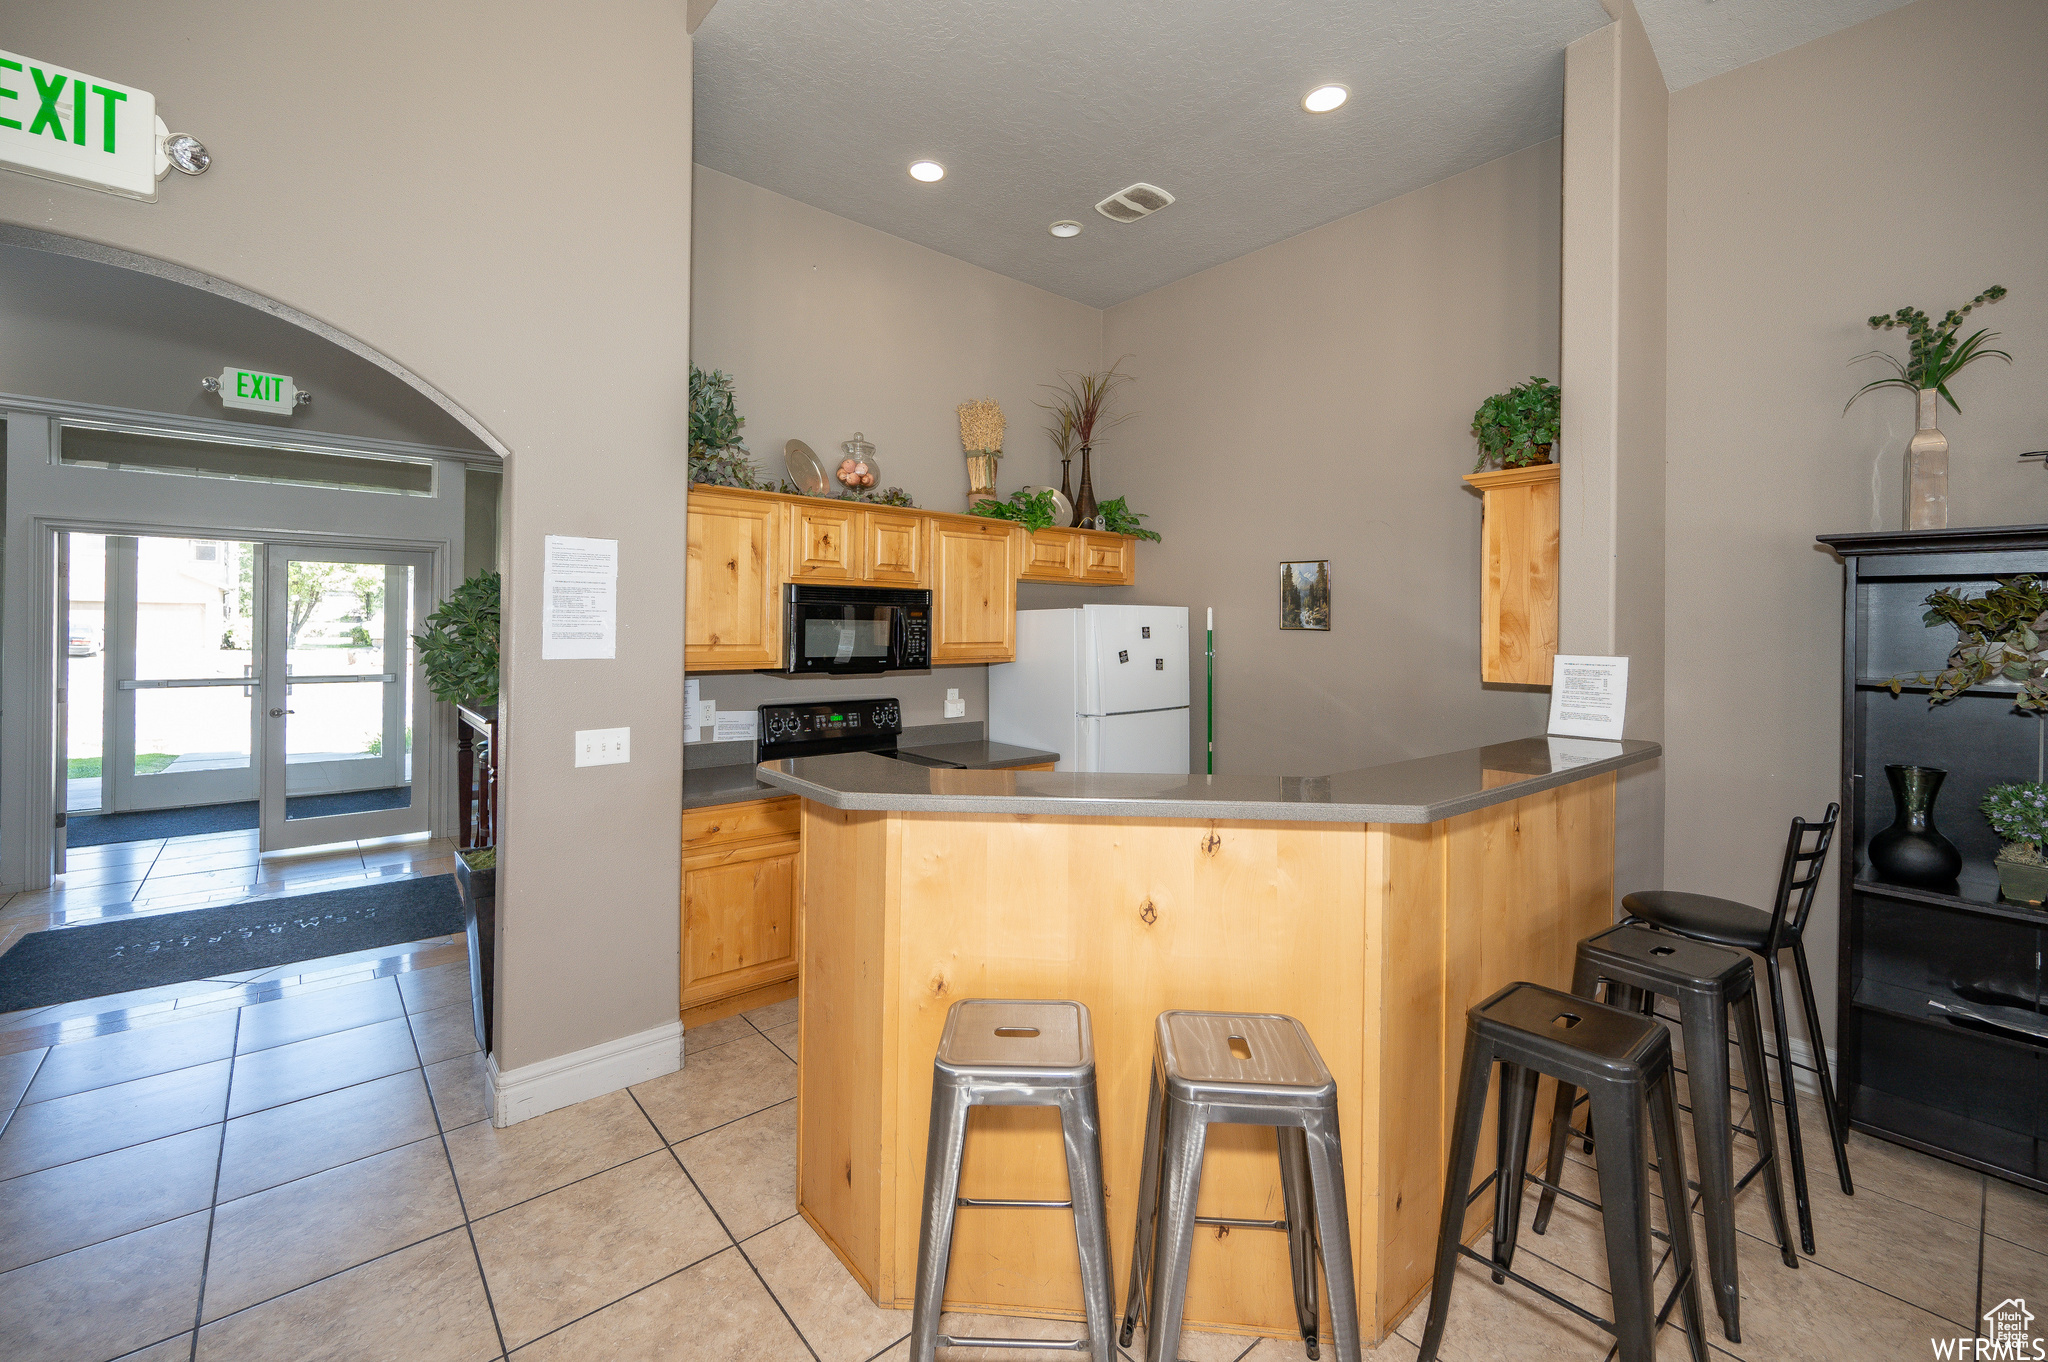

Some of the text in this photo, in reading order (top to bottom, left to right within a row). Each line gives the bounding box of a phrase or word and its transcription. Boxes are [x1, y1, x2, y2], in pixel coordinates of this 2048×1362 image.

[0, 58, 127, 154] EXIT
[237, 372, 284, 403] EXIT
[108, 911, 376, 959] PEMBERLEY
